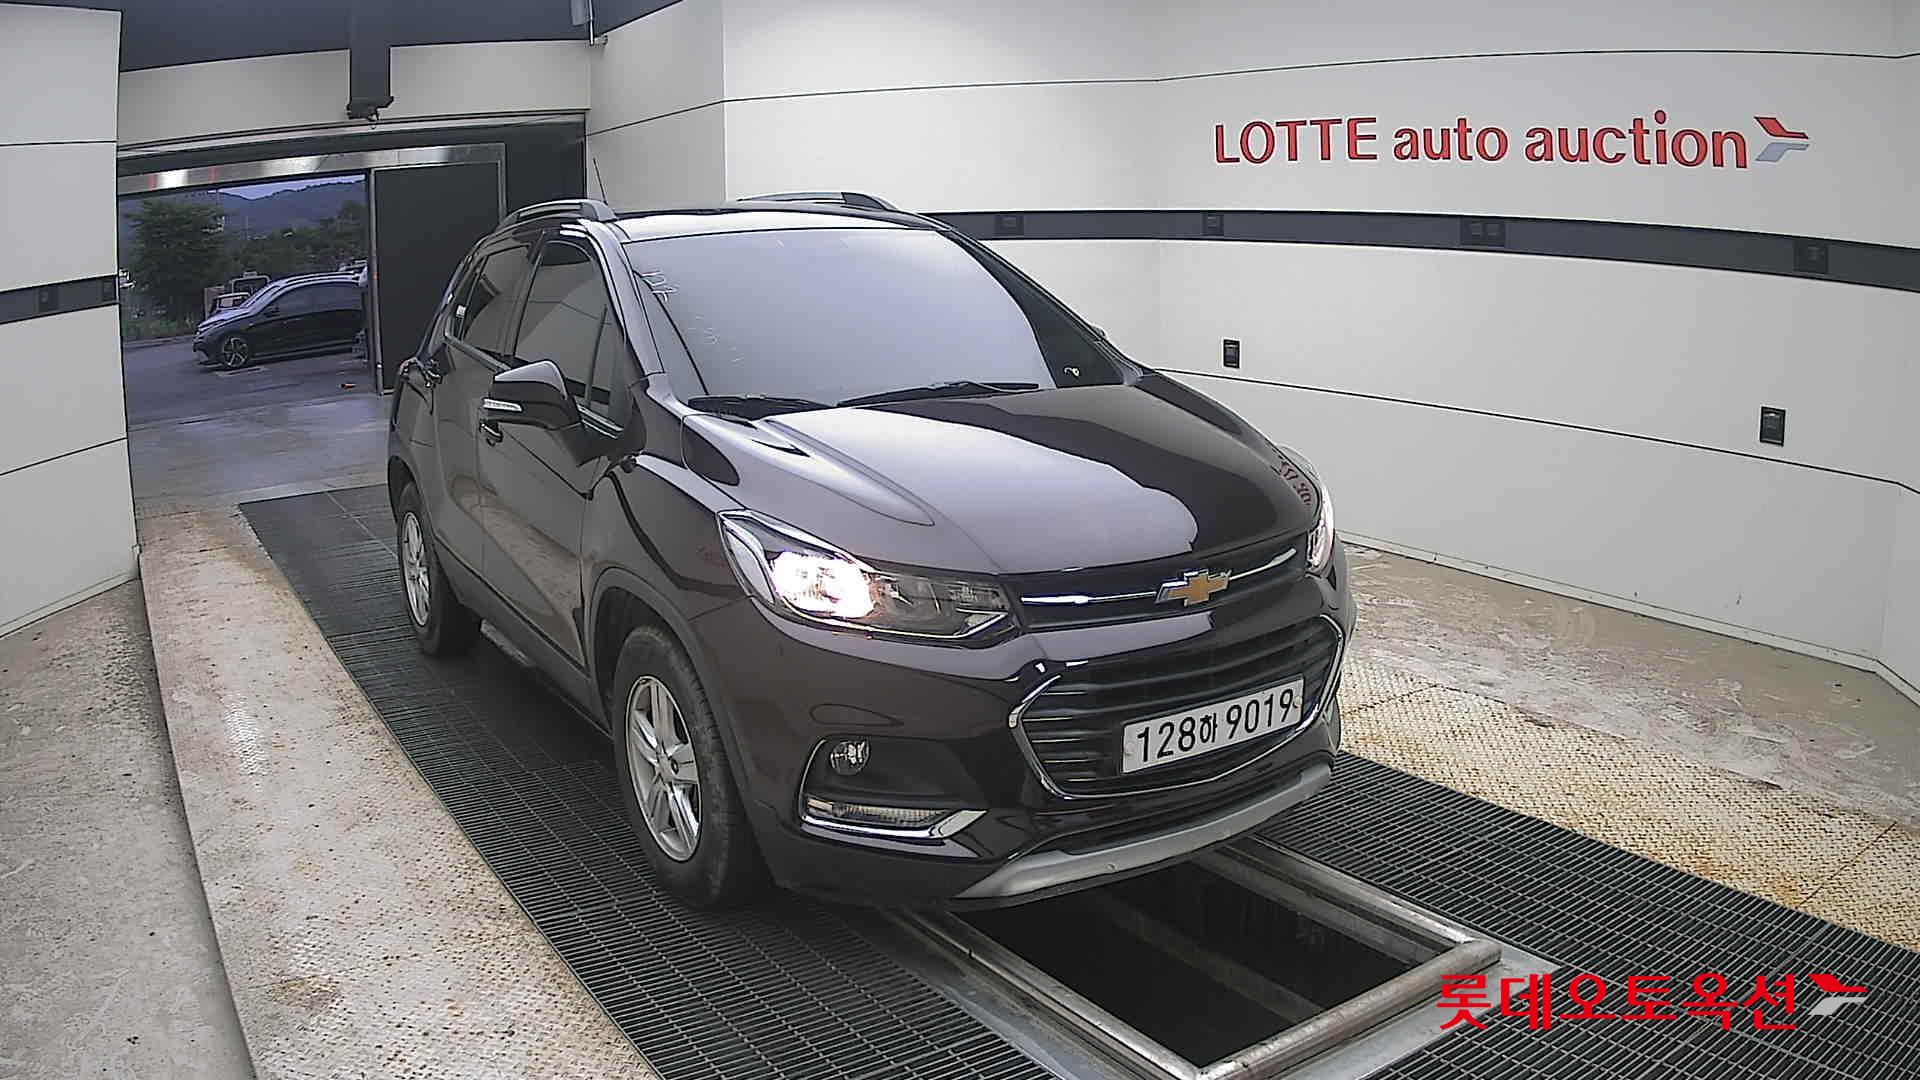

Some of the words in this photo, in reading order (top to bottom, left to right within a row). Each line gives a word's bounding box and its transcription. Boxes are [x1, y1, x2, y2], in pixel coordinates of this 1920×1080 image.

[1215, 117, 1377, 163] LOTTE
[1393, 117, 1508, 162] auto
[1524, 111, 1748, 169] auction
[1136, 711, 1218, 763] 128하
[1226, 688, 1294, 740] 9019
